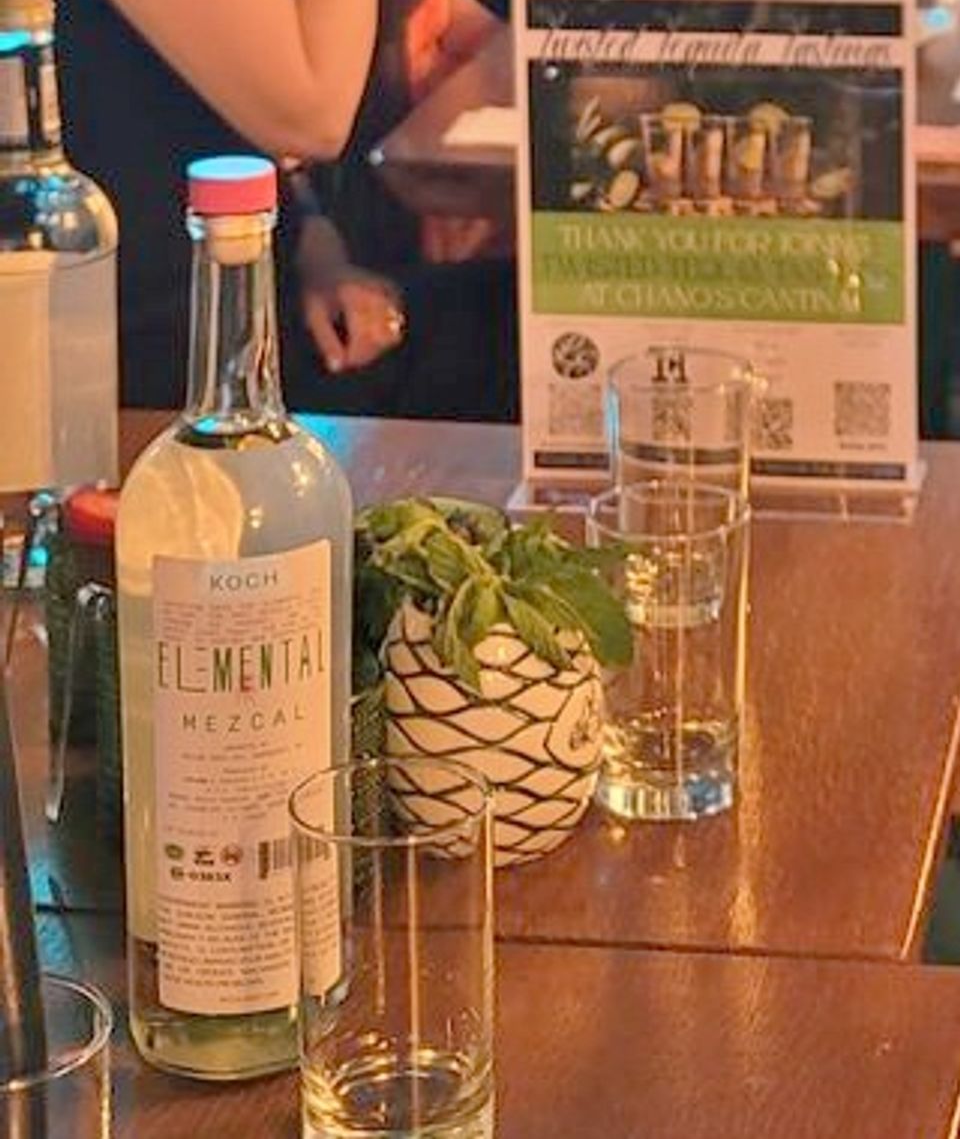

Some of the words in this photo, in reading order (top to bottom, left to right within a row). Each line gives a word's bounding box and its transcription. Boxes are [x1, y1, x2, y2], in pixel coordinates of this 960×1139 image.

[557, 225, 643, 250] THANK
[651, 227, 709, 253] YOU
[712, 228, 770, 257] FOR
[579, 282, 609, 308] AT
[209, 570, 278, 591] KOCH
[182, 705, 305, 733] MEZCAL
